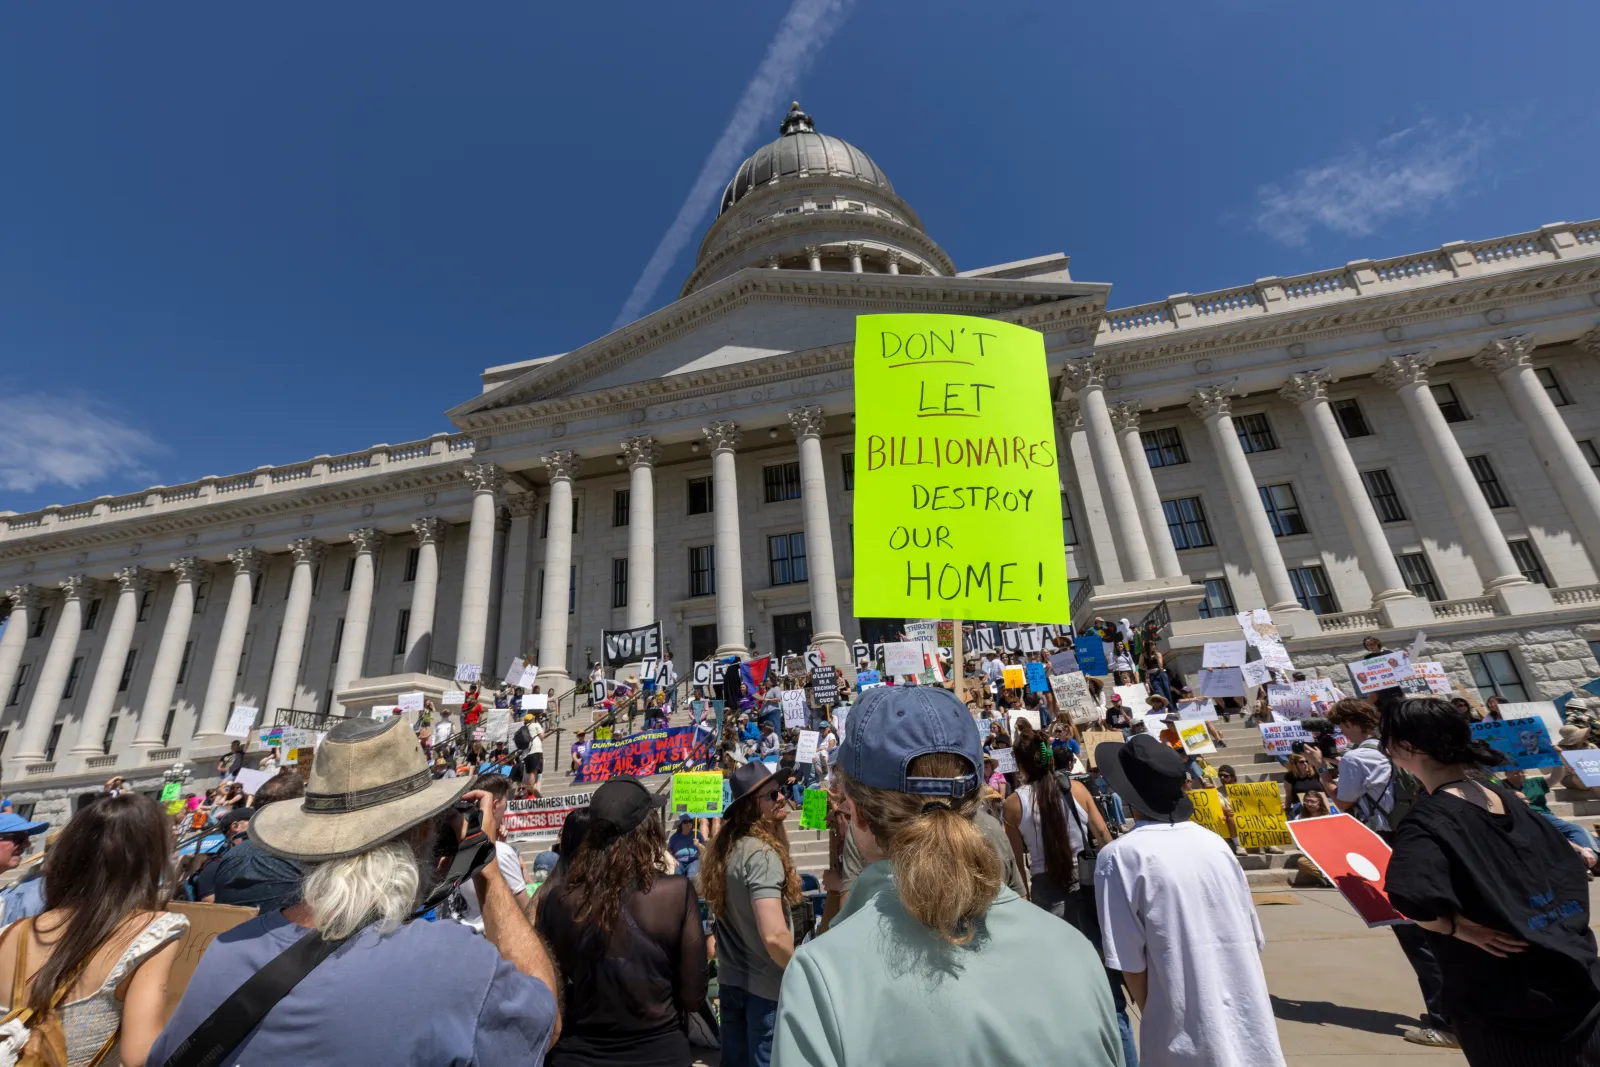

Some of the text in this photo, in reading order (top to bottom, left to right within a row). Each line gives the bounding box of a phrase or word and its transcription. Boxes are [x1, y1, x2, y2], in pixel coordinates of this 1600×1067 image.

[882, 328, 997, 359] DON'T
[669, 395, 738, 418] STATE
[751, 386, 776, 401] OF
[918, 381, 995, 413] LET
[867, 435, 1055, 471] BILLIONAIRES
[912, 485, 1033, 512] DESTROY
[889, 525, 954, 550] OUR
[907, 623, 935, 632] THIRSTY
[606, 627, 658, 660] VOTE
[783, 689, 806, 701] COX
[1508, 717, 1535, 727] BAD
[615, 739, 632, 747] DATA
[633, 732, 668, 742] CENTERS
[591, 748, 622, 763] SAVE
[625, 740, 652, 757] OUR
[582, 761, 611, 775] OUR
[1228, 782, 1278, 798] KEVIN THINKS
[509, 792, 594, 811] BILLIONAIRES! NO DAT
[1257, 799, 1269, 813] A
[503, 811, 567, 829] WORKERS DEC
[1235, 813, 1287, 831] CHINESE
[1238, 831, 1292, 847] OPERATIVE
